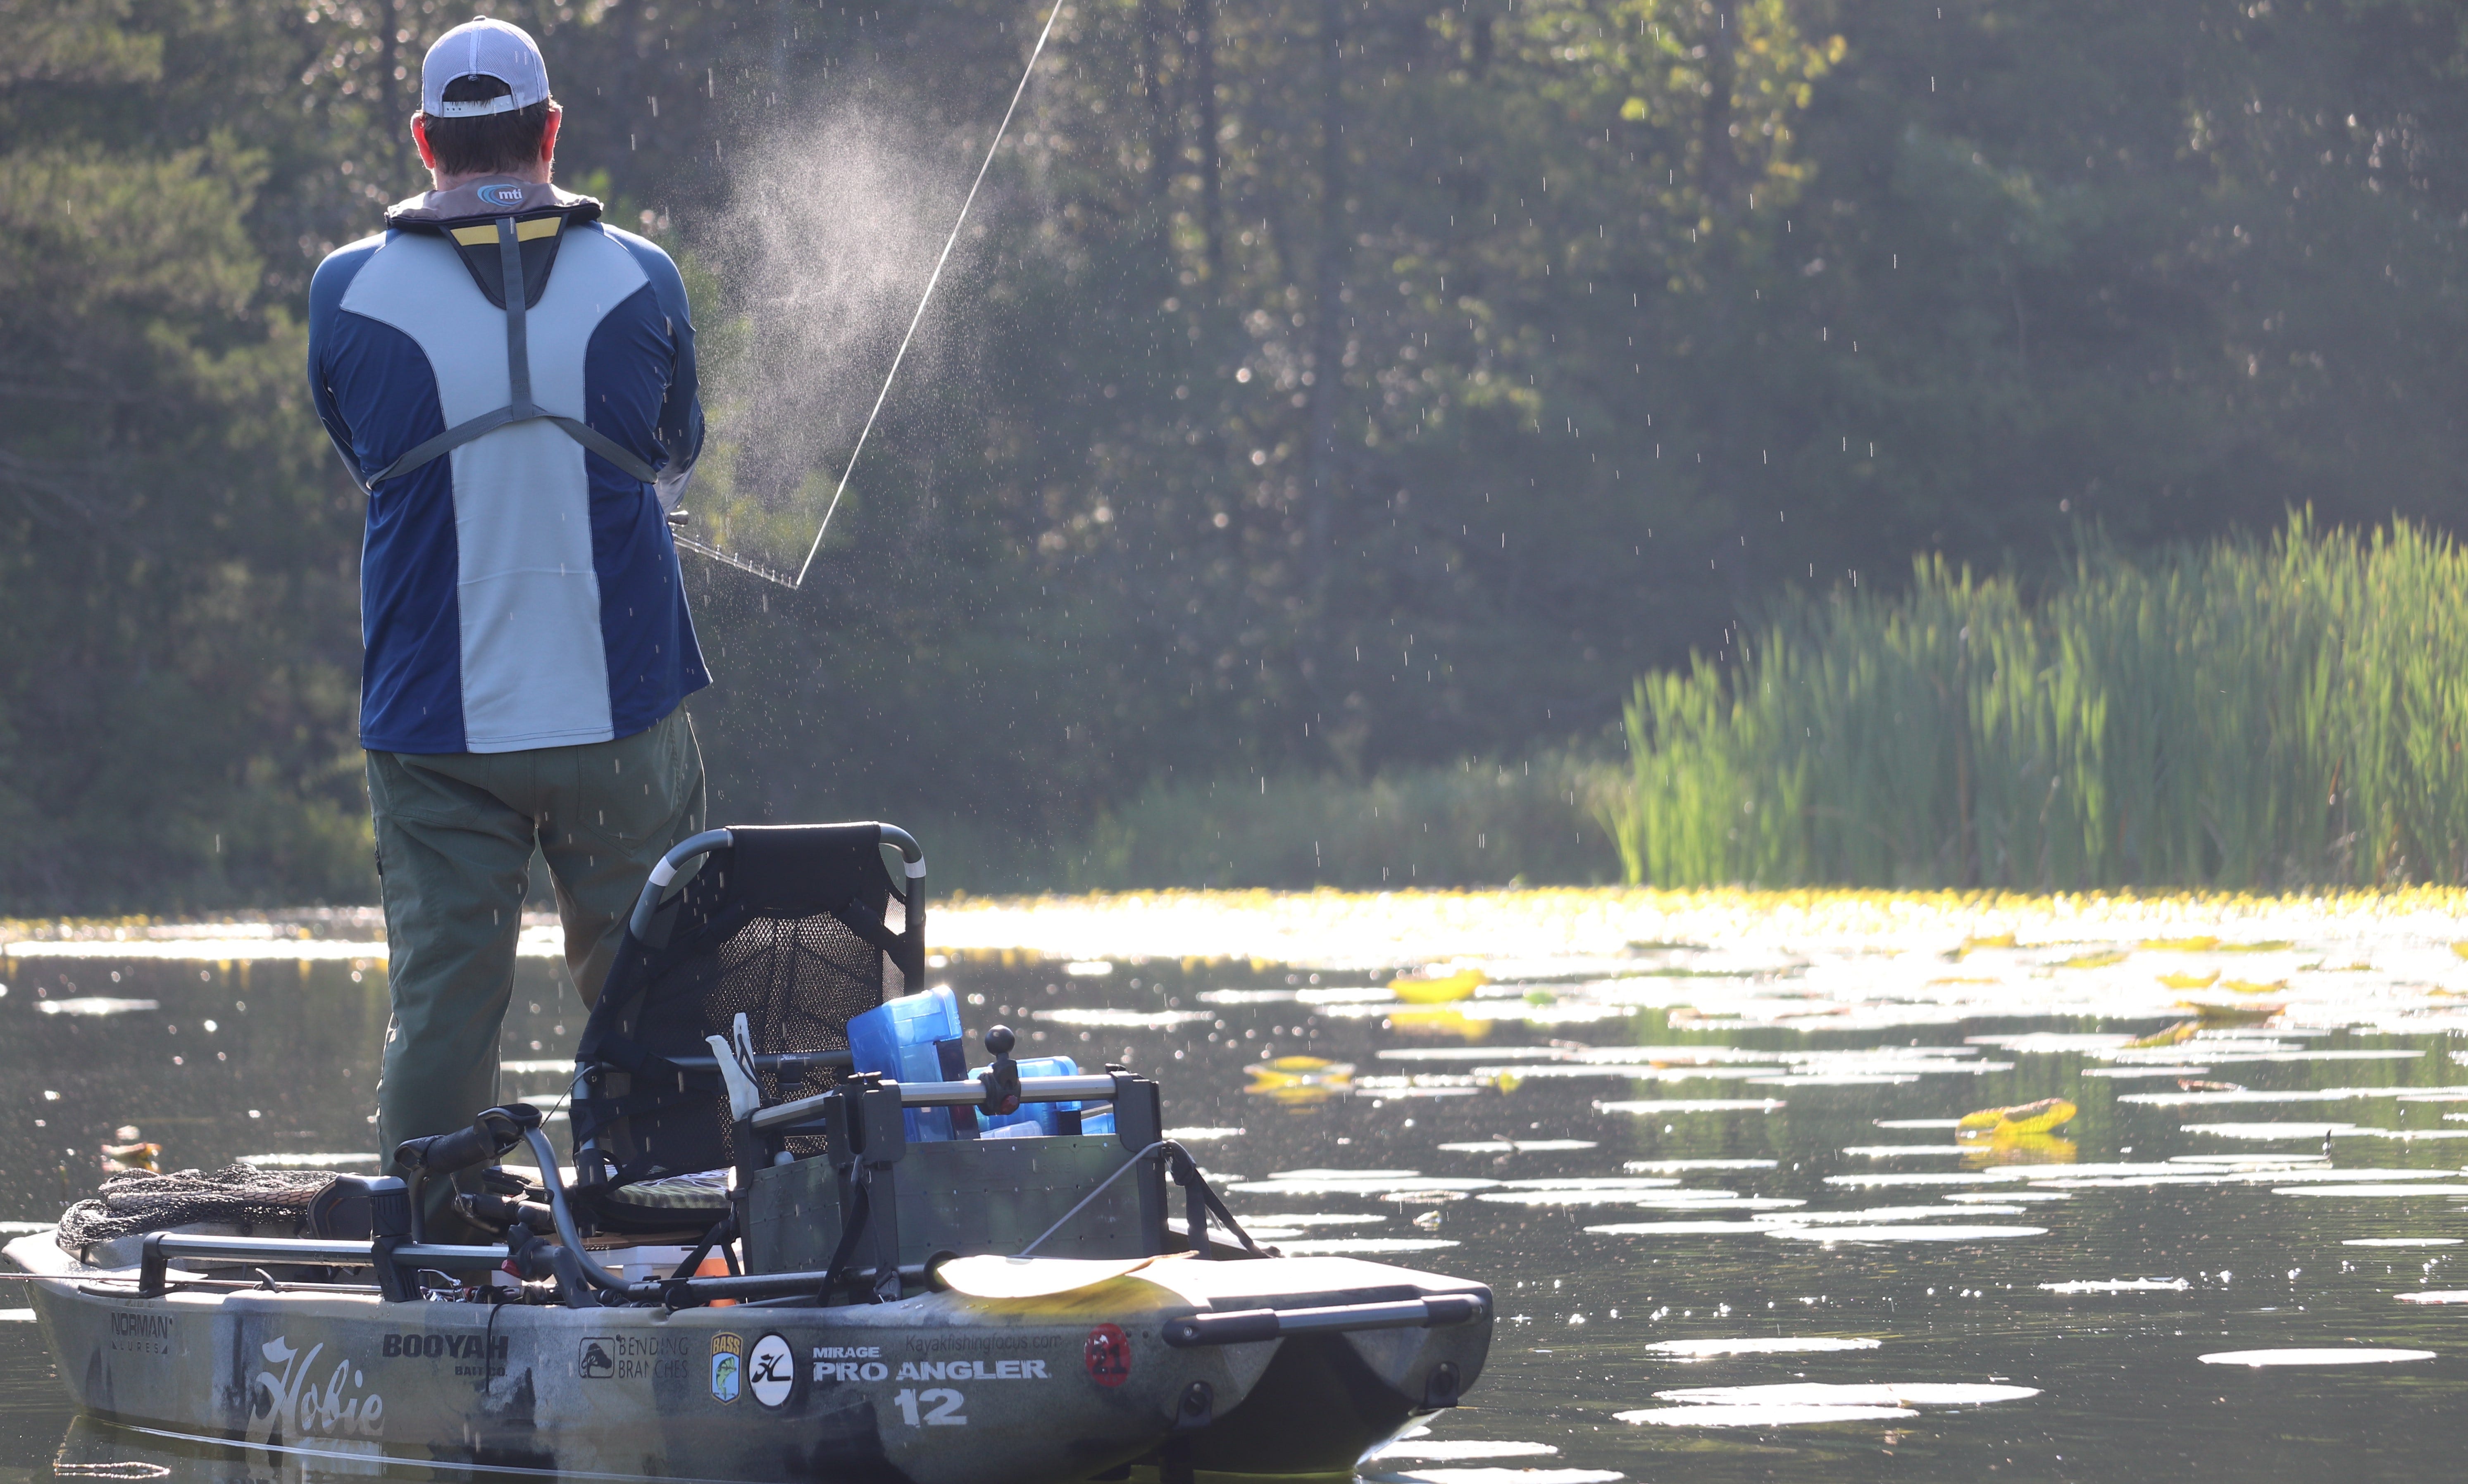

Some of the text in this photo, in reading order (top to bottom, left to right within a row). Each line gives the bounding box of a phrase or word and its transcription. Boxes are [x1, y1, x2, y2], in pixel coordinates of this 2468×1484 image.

[498, 189, 522, 199] mti
[111, 1311, 167, 1339] NORMAN
[120, 1341, 158, 1353] LURES
[382, 1334, 509, 1359] BOOYAH
[619, 1337, 688, 1355] BENDING
[713, 1336, 740, 1356] BASS
[813, 1346, 879, 1358] MIRAGE
[906, 1333, 1061, 1354] Kayakfishingfocus.com
[1091, 1344, 1127, 1374] 21
[455, 1366, 482, 1376] BAIT
[813, 1360, 1048, 1382] PRO ANGLER
[245, 1335, 384, 1452] Hobie
[894, 1388, 967, 1428] 12
